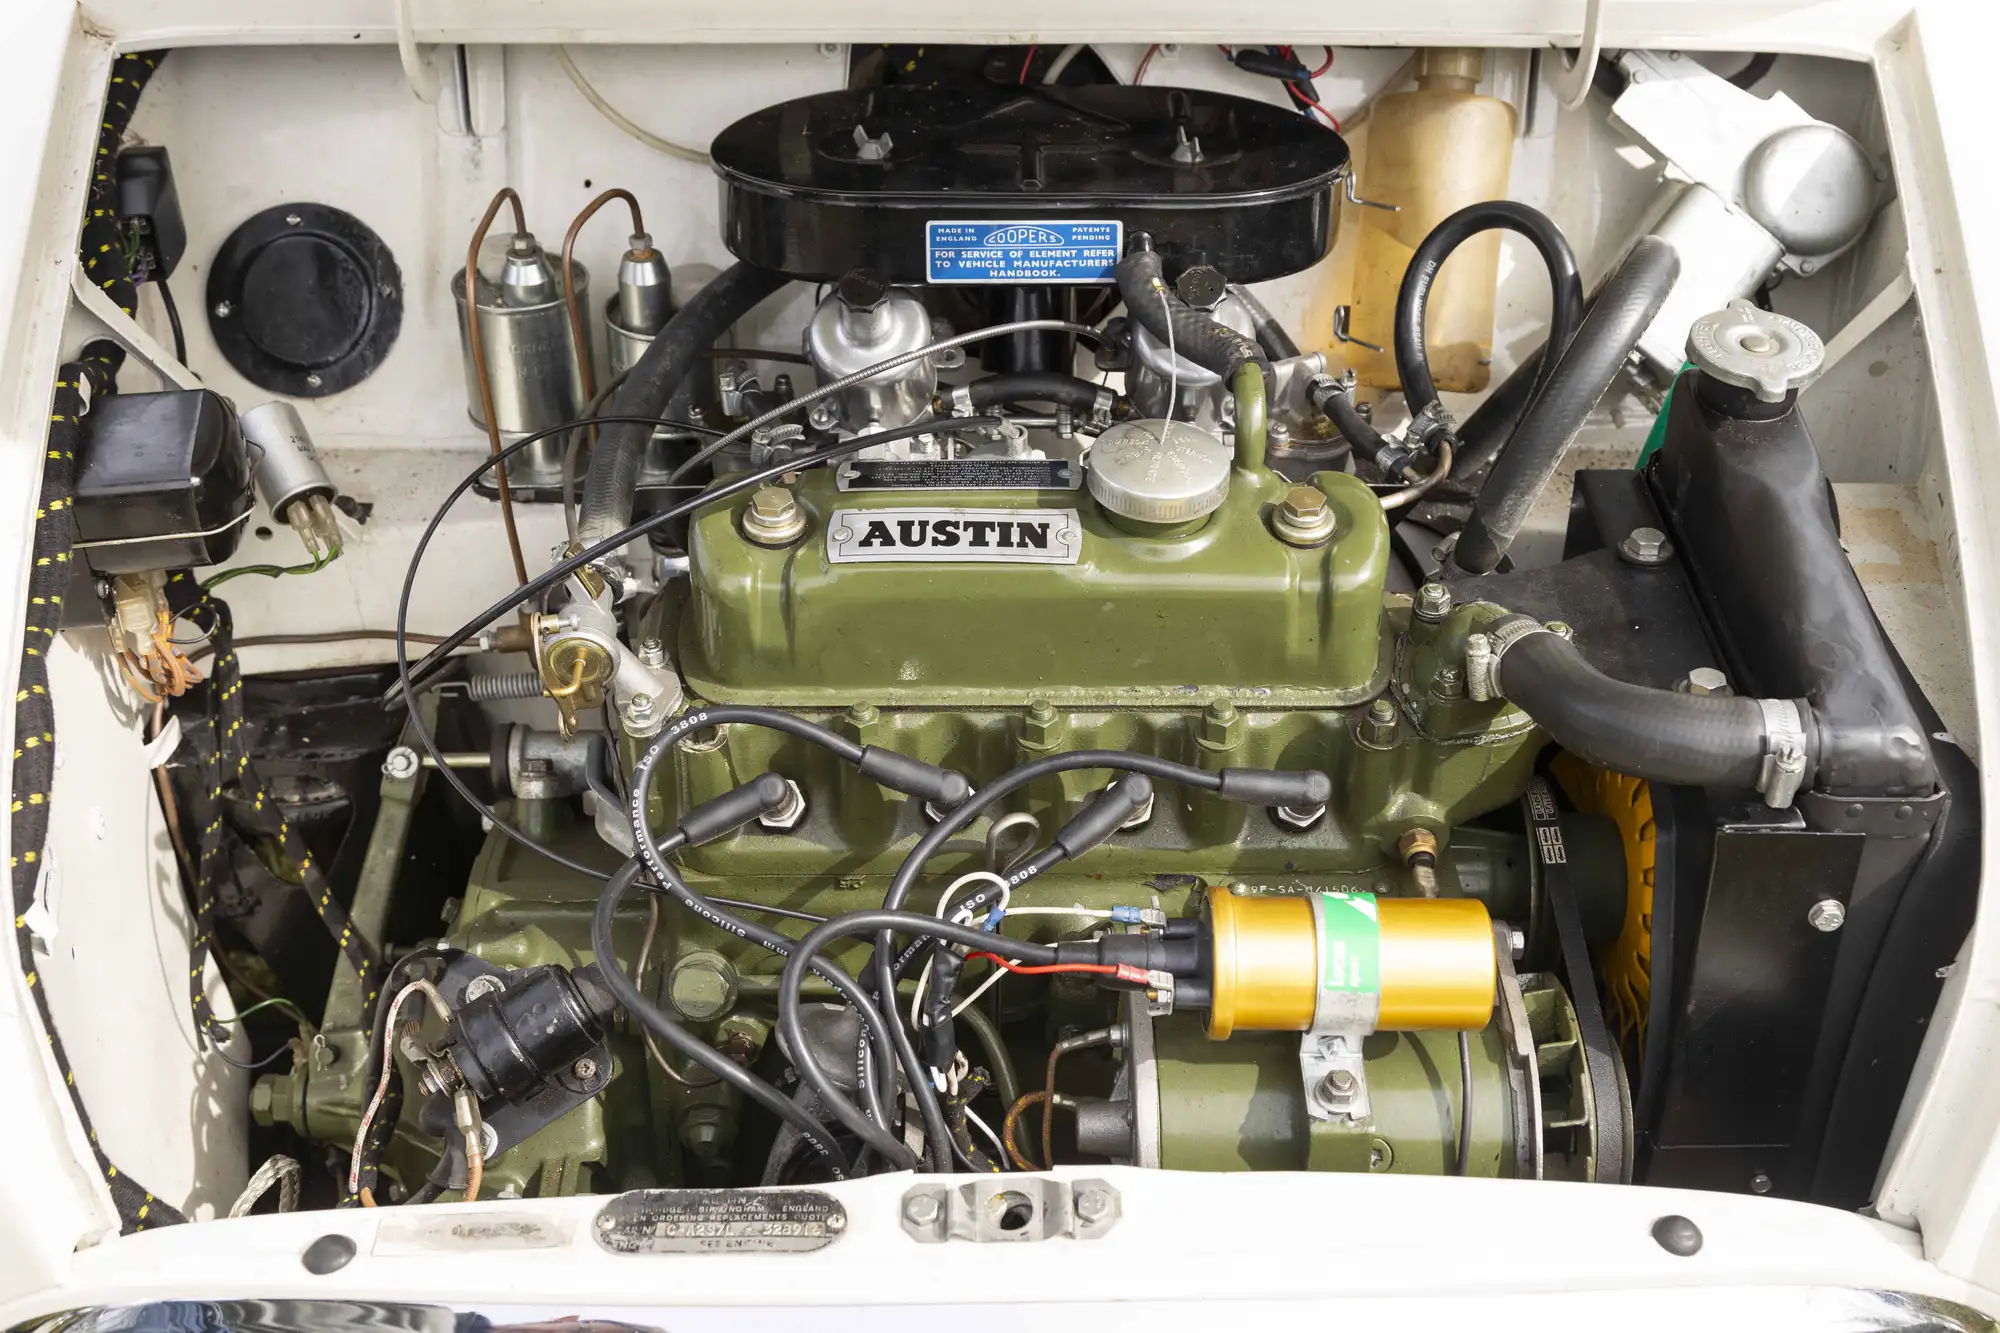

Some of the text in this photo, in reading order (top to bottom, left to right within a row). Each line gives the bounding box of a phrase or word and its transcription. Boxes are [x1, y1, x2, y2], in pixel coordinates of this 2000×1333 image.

[935, 249, 1114, 258] FOR SERVICE OF ELEMENT REFER
[935, 259, 1114, 268] TO VEHICLE MANUFACTURERS
[989, 269, 1061, 277] HANDBOOK.
[858, 519, 1050, 549] AUSTIN
[670, 712, 708, 735] 3808
[638, 745, 659, 771] ISO
[632, 788, 672, 890] Performance
[684, 898, 746, 938] Silicone
[857, 1028, 868, 1089] Silicon
[651, 1213, 704, 1222] ORDERING
[709, 1213, 788, 1221] REPLACEMENTS
[782, 1204, 829, 1212] ENGLAND
